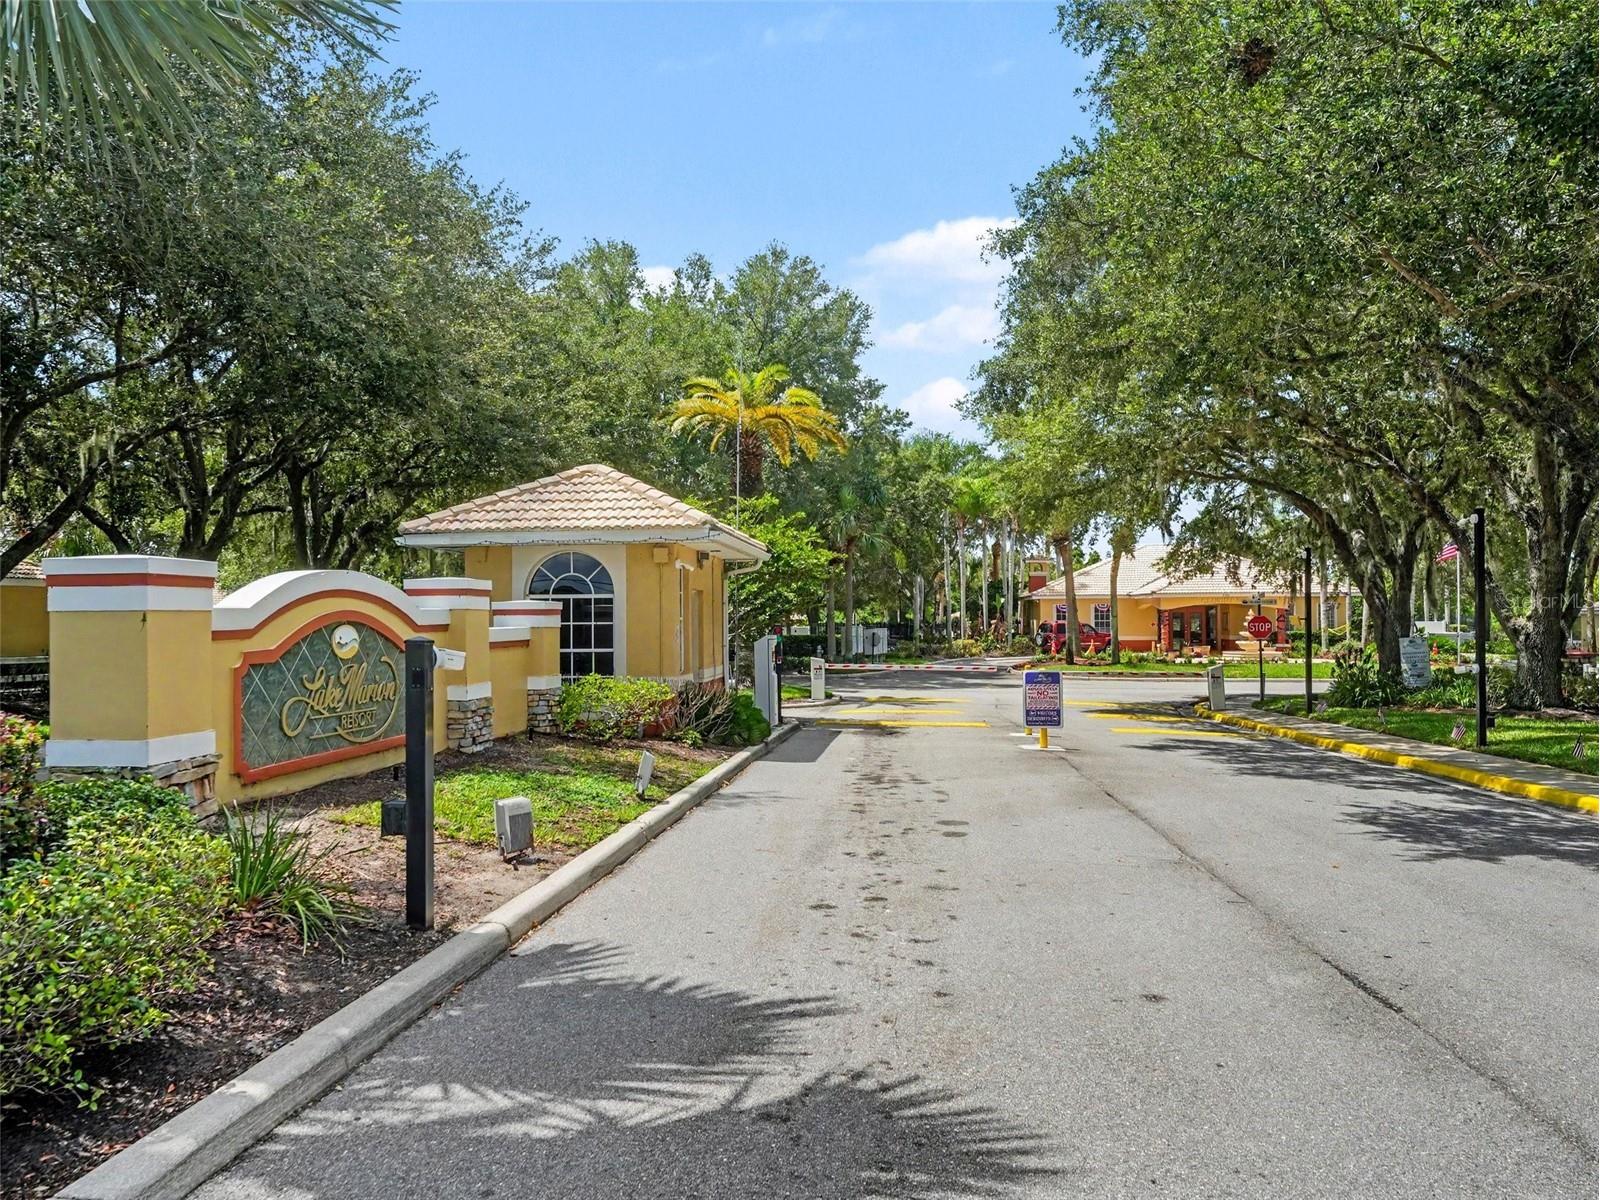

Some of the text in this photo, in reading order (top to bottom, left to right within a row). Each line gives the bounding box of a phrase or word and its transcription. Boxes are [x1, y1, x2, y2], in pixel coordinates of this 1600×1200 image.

[1249, 622, 1271, 632] STOP
[336, 662, 396, 711] Marion
[341, 711, 376, 729] RESORT
